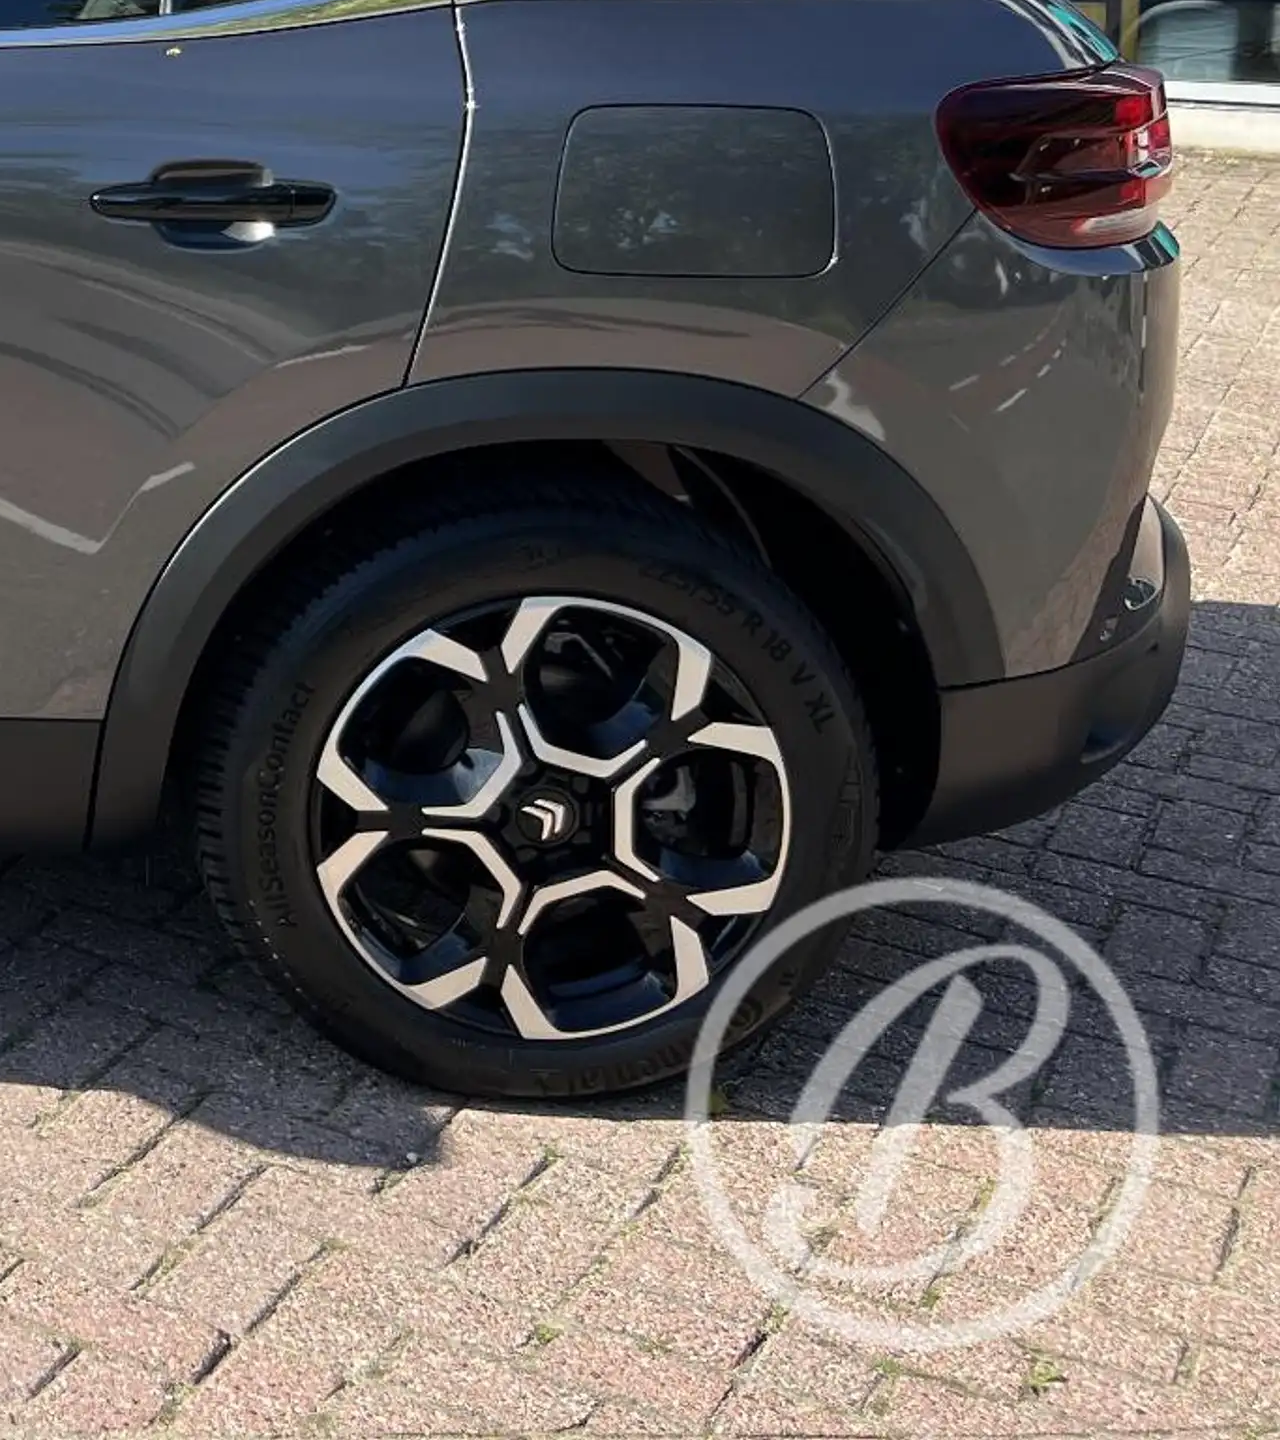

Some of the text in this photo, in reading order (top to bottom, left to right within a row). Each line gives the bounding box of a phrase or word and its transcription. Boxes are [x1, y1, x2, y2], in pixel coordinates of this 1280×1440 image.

[760, 629, 793, 663] 18
[803, 691, 837, 734] XL
[256, 680, 317, 928] AllSeasonContact
